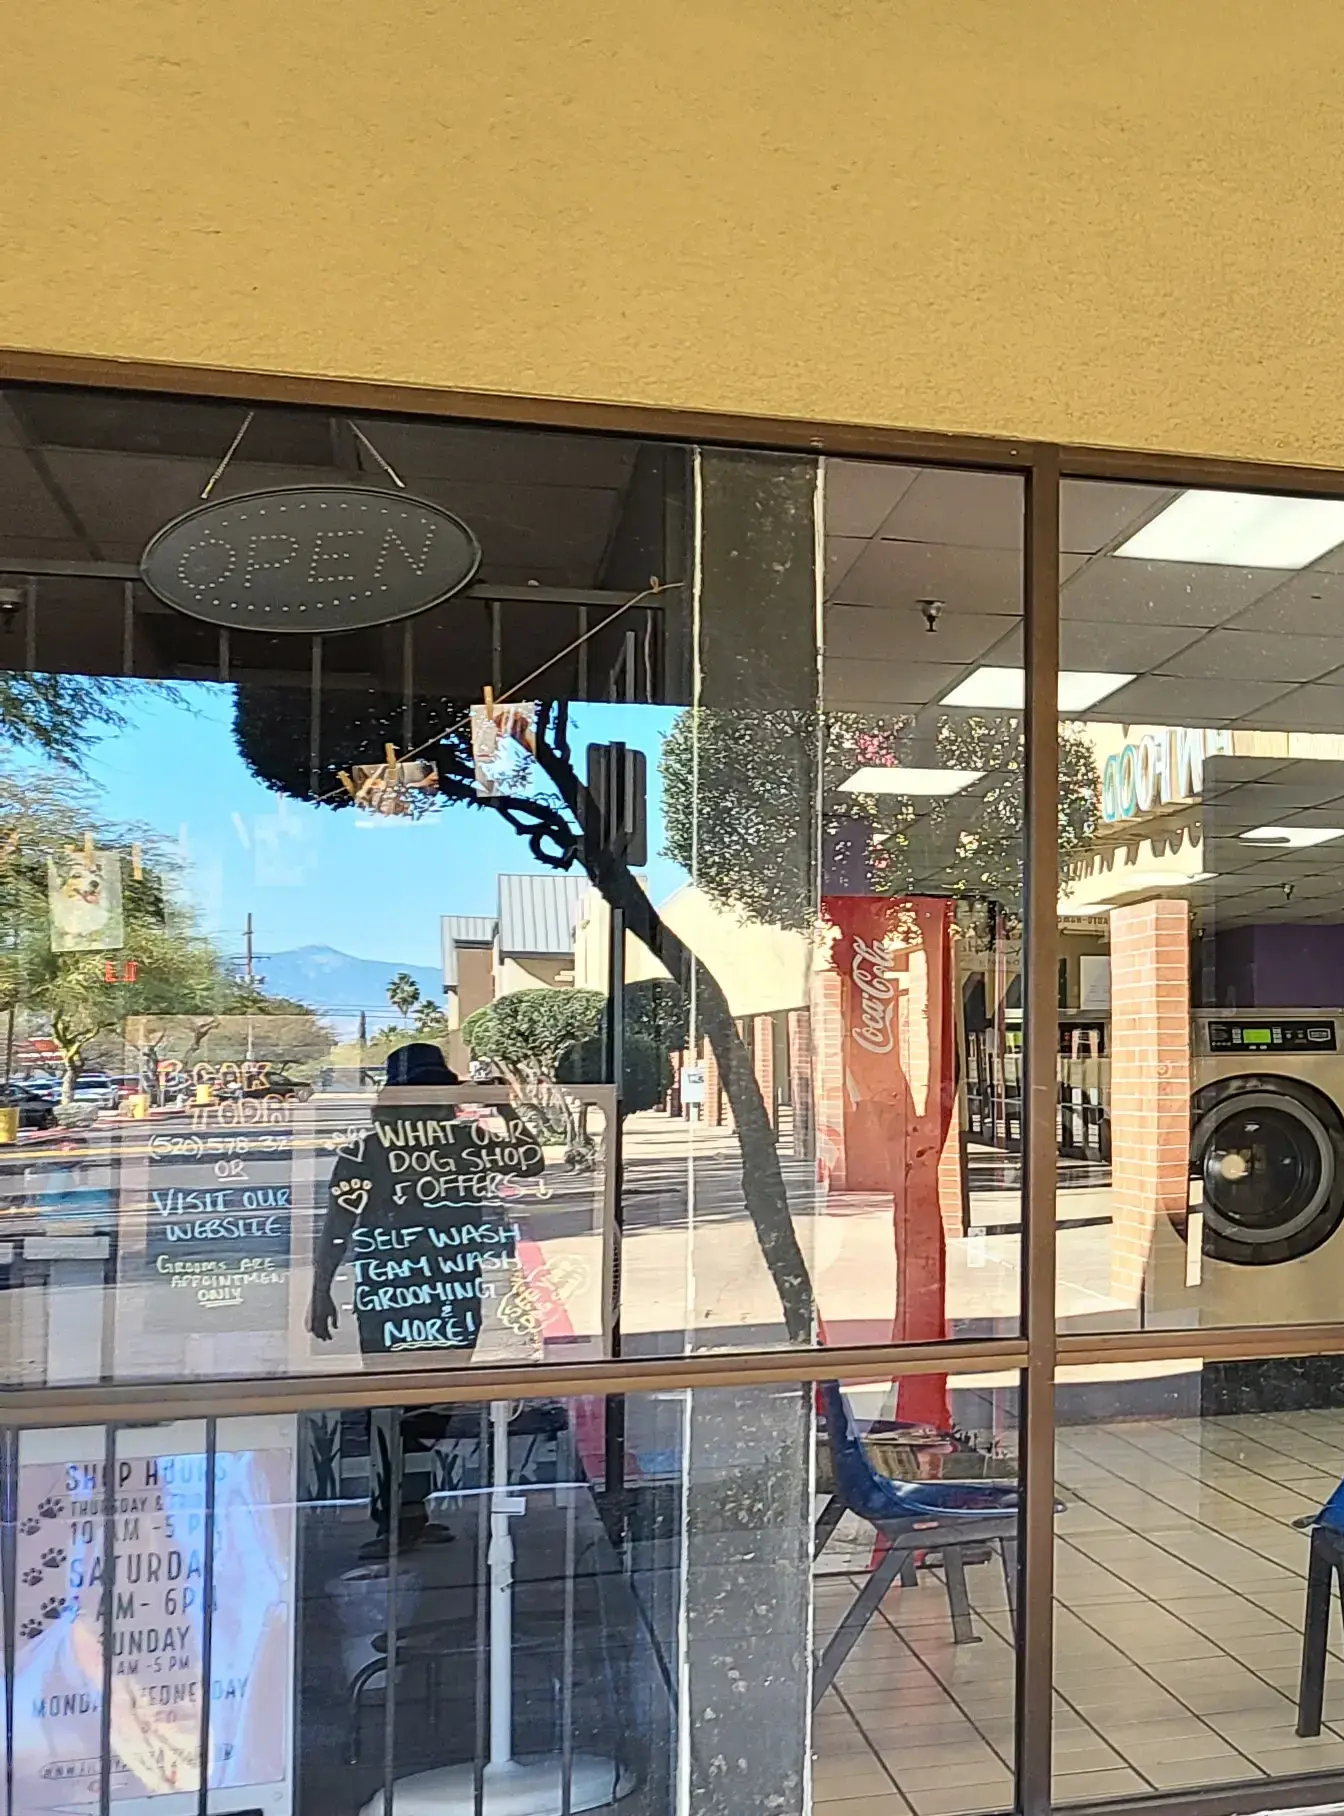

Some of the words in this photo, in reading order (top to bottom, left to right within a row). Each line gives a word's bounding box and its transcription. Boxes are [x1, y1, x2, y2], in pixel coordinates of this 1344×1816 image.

[178, 524, 437, 590] OPEN
[374, 1119, 456, 1149] WHAT
[214, 1159, 246, 1178] OR
[388, 1150, 457, 1174] DOG
[461, 1144, 542, 1172] SHOP
[416, 1173, 523, 1201] OFFERS
[152, 1189, 234, 1217] VISIT
[242, 1188, 291, 1209] OUR
[165, 1215, 282, 1242] WEBSITE
[352, 1226, 424, 1252] SELF
[429, 1223, 521, 1248] WASH
[347, 1255, 432, 1283] TEAM
[437, 1250, 522, 1275] WASH
[355, 1278, 497, 1312] GROOMING
[384, 1311, 477, 1348] MORE!
[65, 1461, 133, 1492] SHP
[70, 1519, 95, 1546] 10
[98, 1625, 190, 1657] UNDAY
[116, 1660, 139, 1676] AM
[168, 1654, 190, 1672] PM
